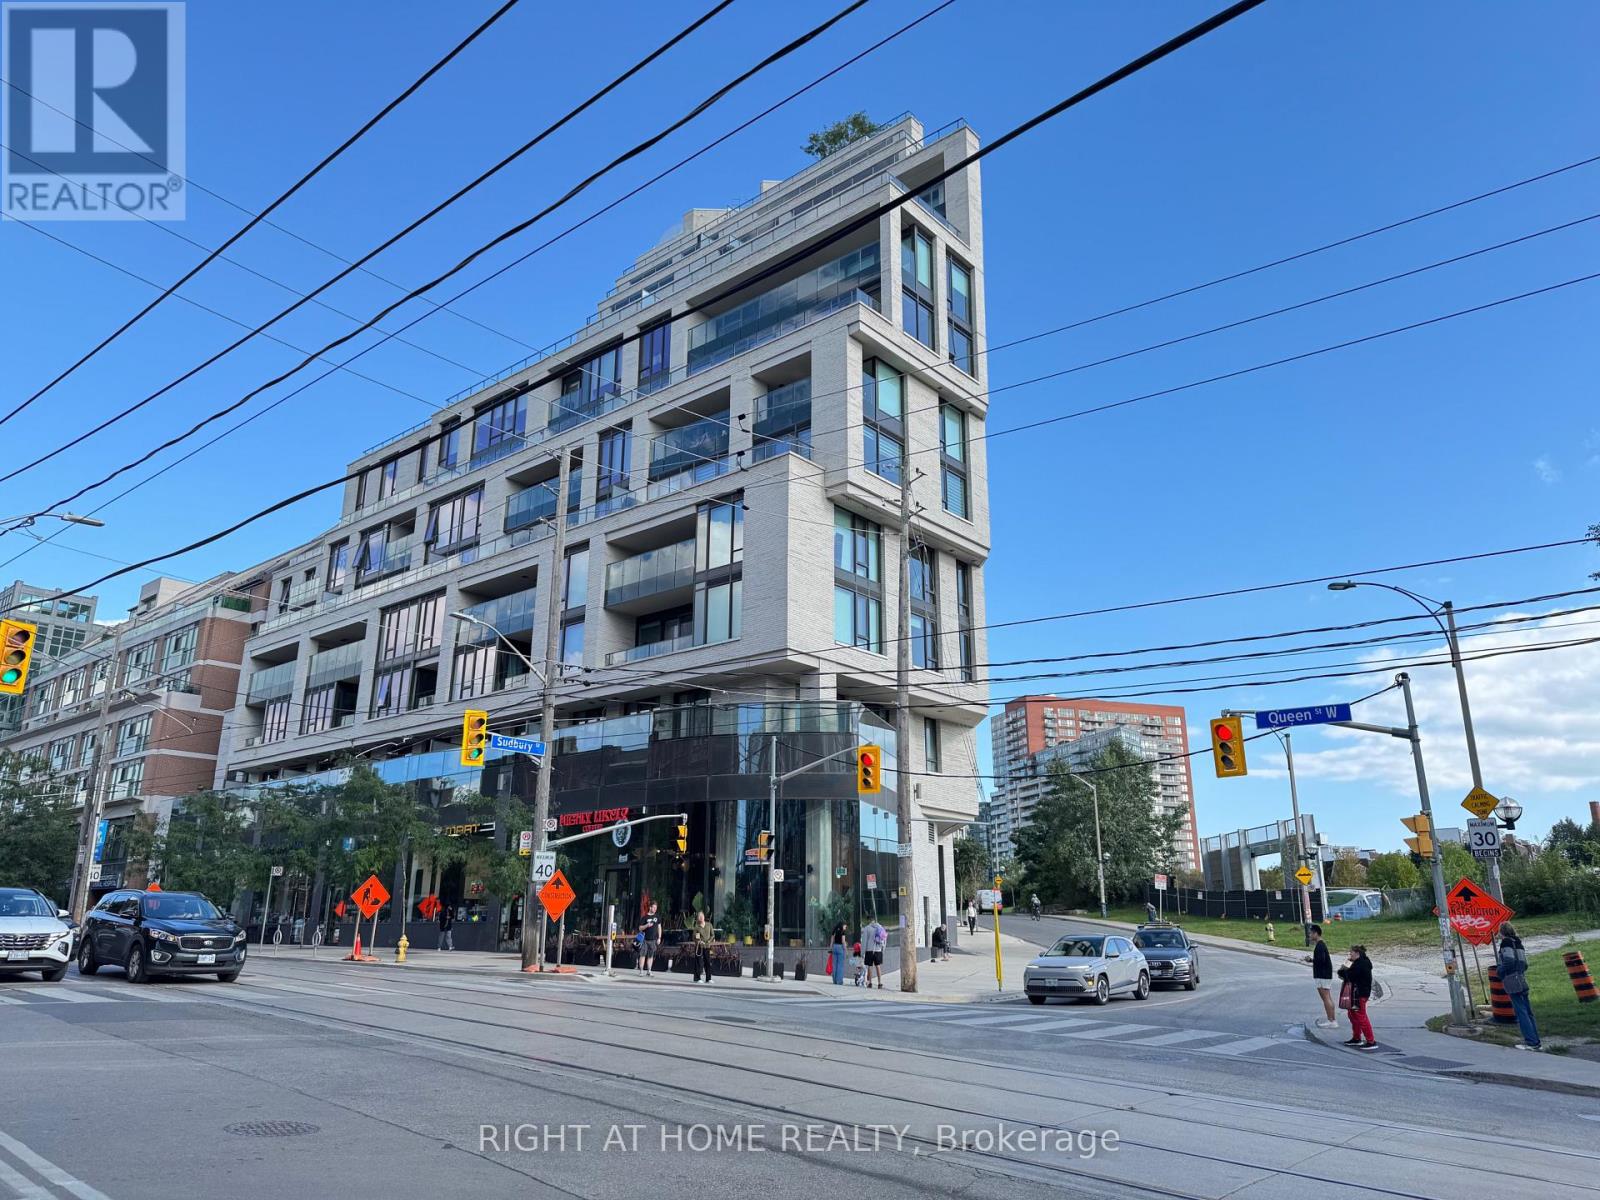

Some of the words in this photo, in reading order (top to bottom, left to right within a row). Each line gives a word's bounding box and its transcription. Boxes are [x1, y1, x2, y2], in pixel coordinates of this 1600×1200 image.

[1268, 711, 1312, 724] Queen
[1325, 706, 1337, 719] W
[497, 737, 533, 753] Sudbury
[1473, 831, 1496, 846] 30
[1474, 849, 1499, 857] BEGINS
[535, 864, 553, 878] 40
[1449, 907, 1500, 917] NSTRUCTION
